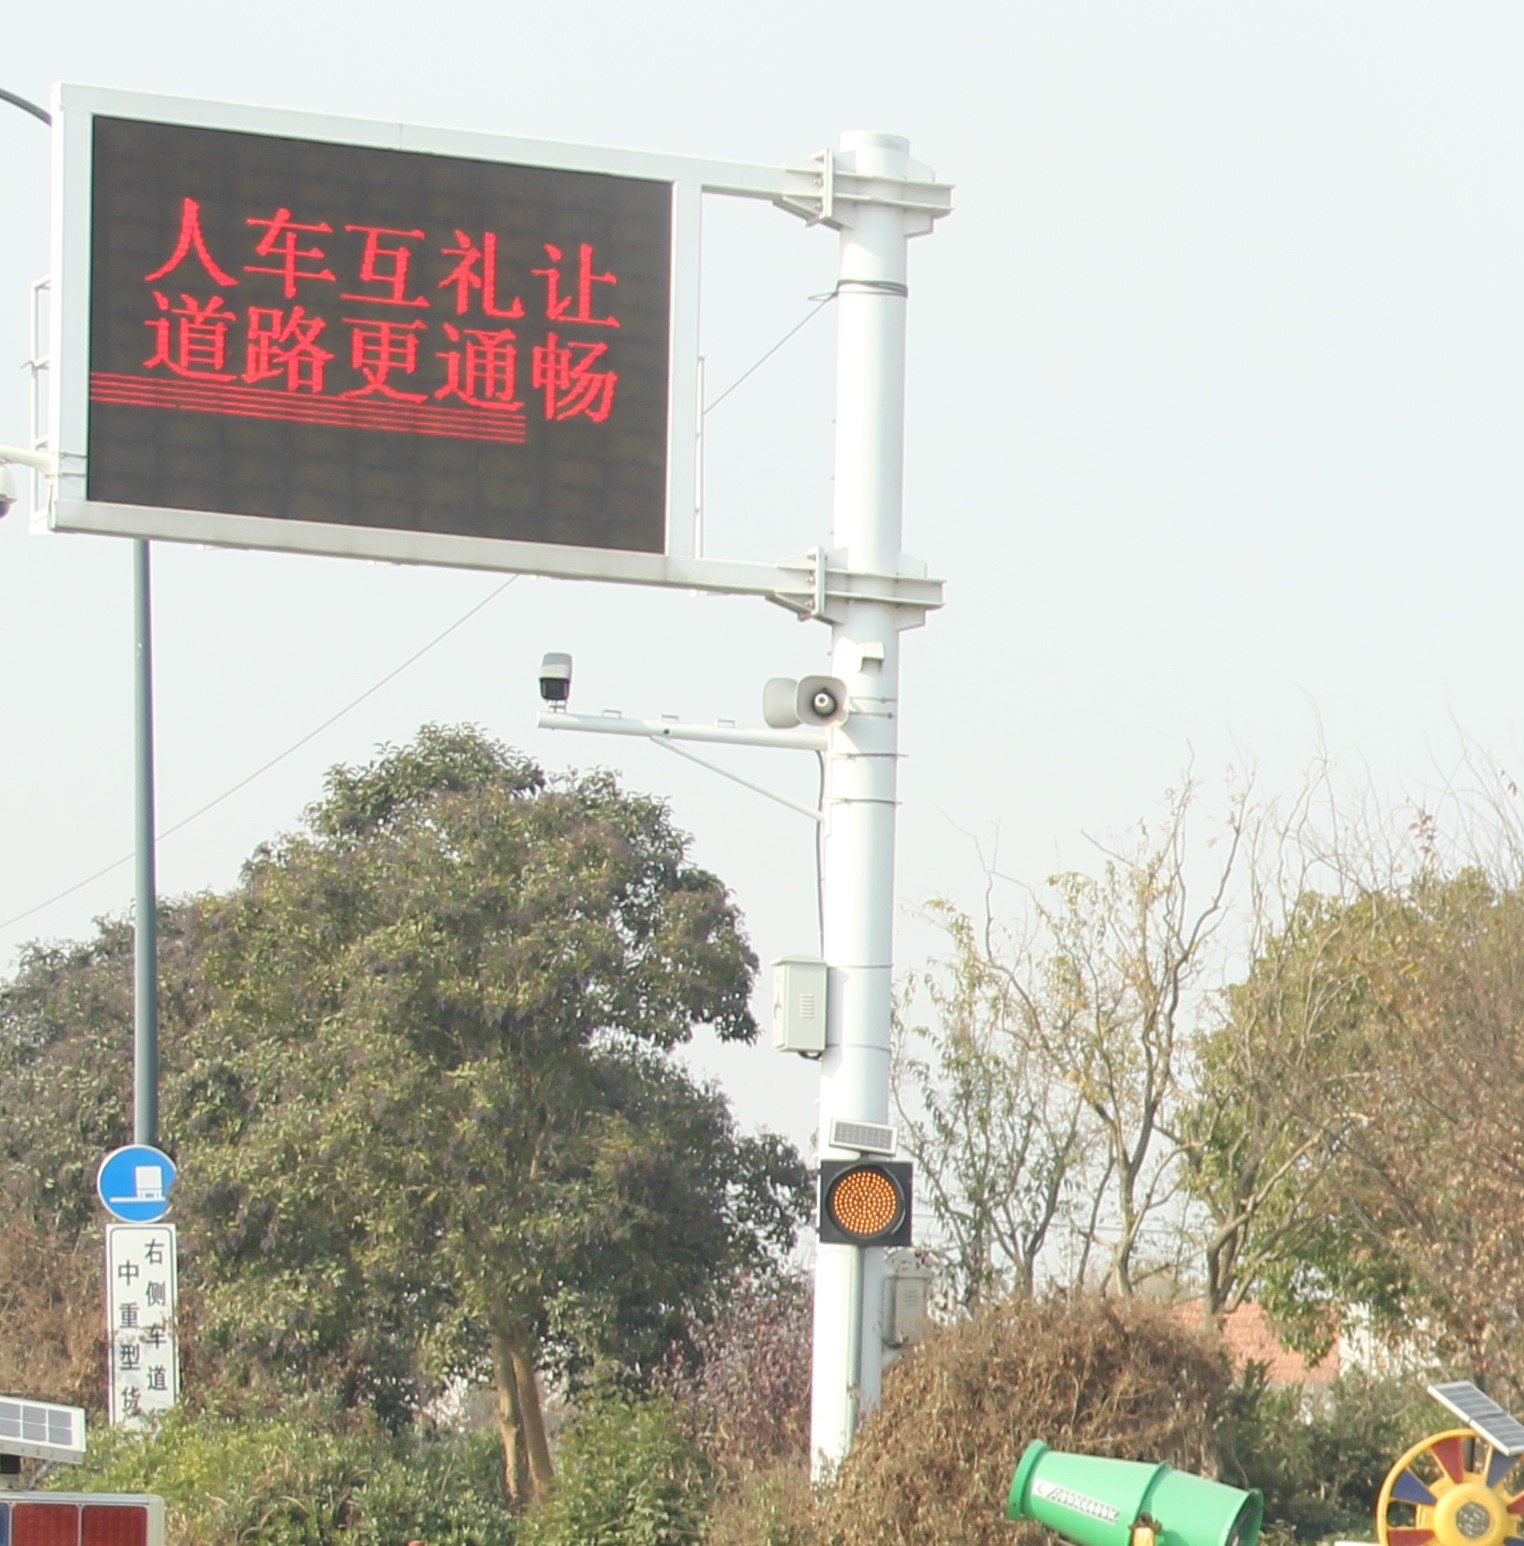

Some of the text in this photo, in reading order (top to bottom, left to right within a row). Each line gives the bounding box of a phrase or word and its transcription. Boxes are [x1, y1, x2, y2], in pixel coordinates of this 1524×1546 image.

[144, 197, 621, 328] 人车互礼让
[142, 291, 619, 423] 道路更通畅
